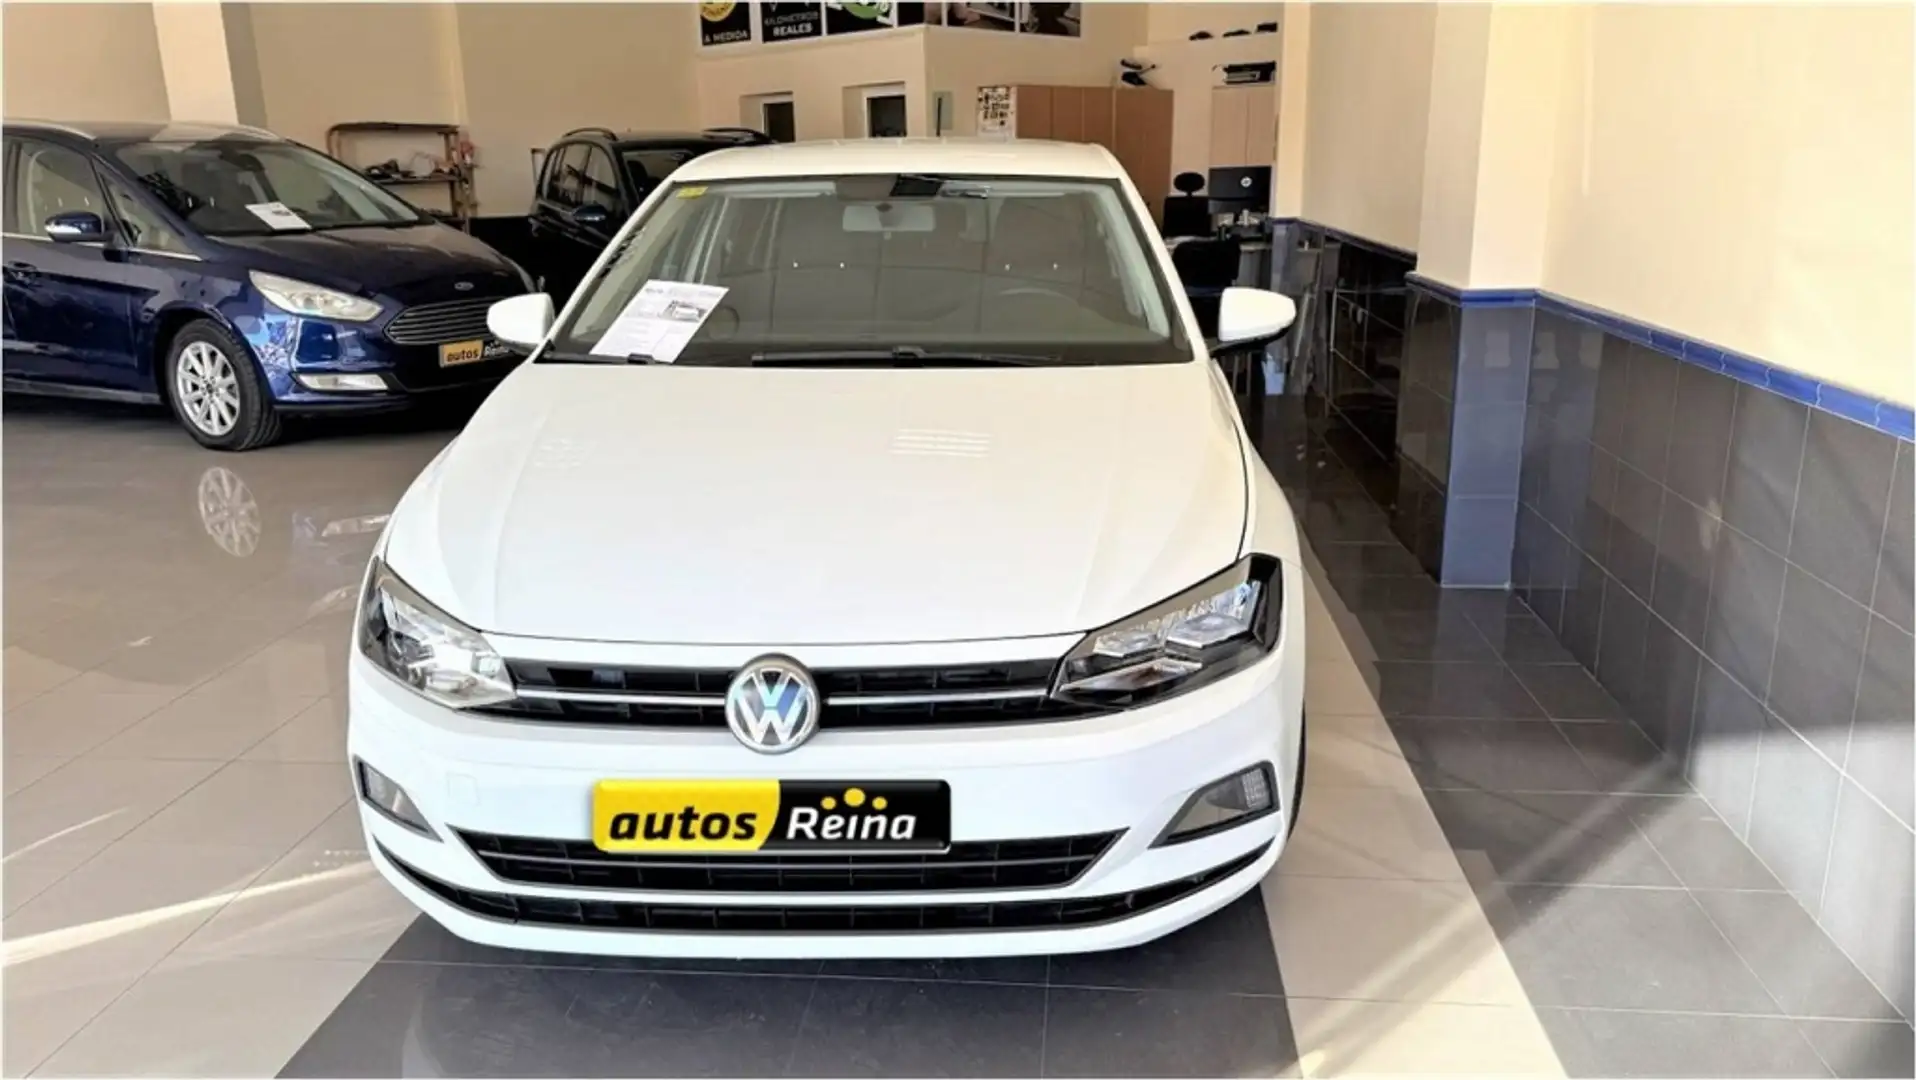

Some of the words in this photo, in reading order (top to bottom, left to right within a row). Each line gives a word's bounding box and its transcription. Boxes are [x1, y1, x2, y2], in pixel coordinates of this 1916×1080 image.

[713, 30, 748, 41] MEDIDA
[773, 22, 813, 36] REALES
[447, 349, 479, 362] autos
[610, 806, 758, 841] autos
[787, 806, 917, 841] Reina
